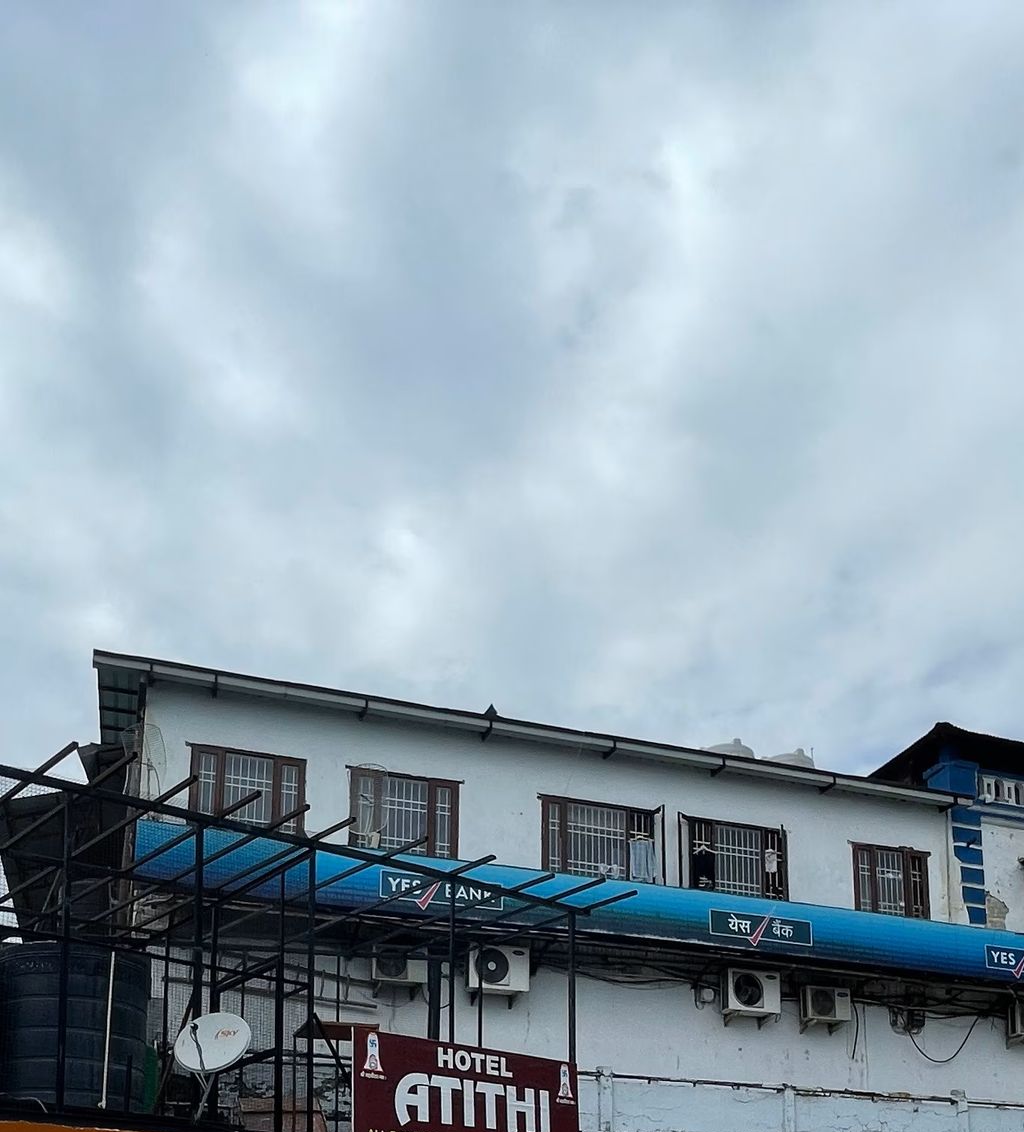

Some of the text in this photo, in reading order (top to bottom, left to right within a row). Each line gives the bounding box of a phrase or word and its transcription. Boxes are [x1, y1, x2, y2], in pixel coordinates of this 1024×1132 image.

[728, 914, 793, 938] येस बैंक
[991, 950, 1016, 965] YES
[437, 1047, 513, 1078] HOTEL
